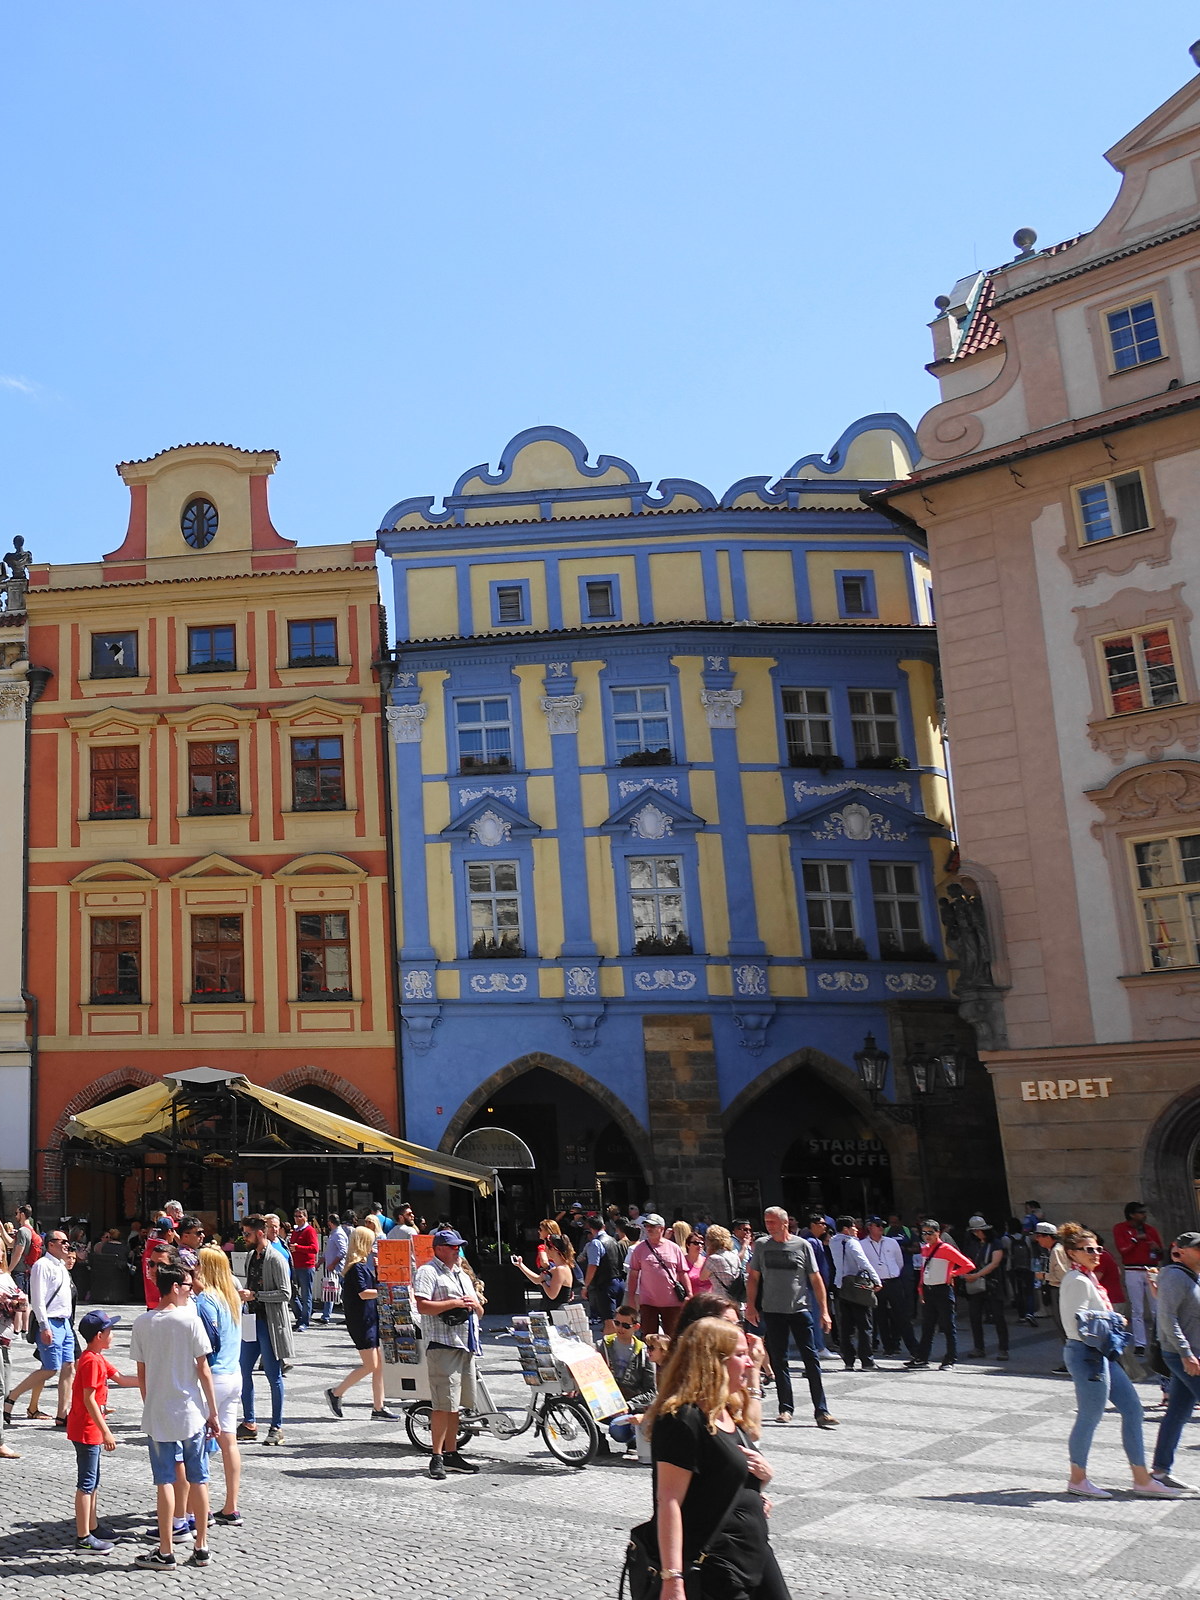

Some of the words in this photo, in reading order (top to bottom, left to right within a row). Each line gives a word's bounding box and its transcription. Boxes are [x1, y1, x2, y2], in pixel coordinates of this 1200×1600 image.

[1021, 1077, 1113, 1101] ERPET
[809, 1139, 883, 1152] STARBU
[831, 1154, 889, 1166] COFFE
